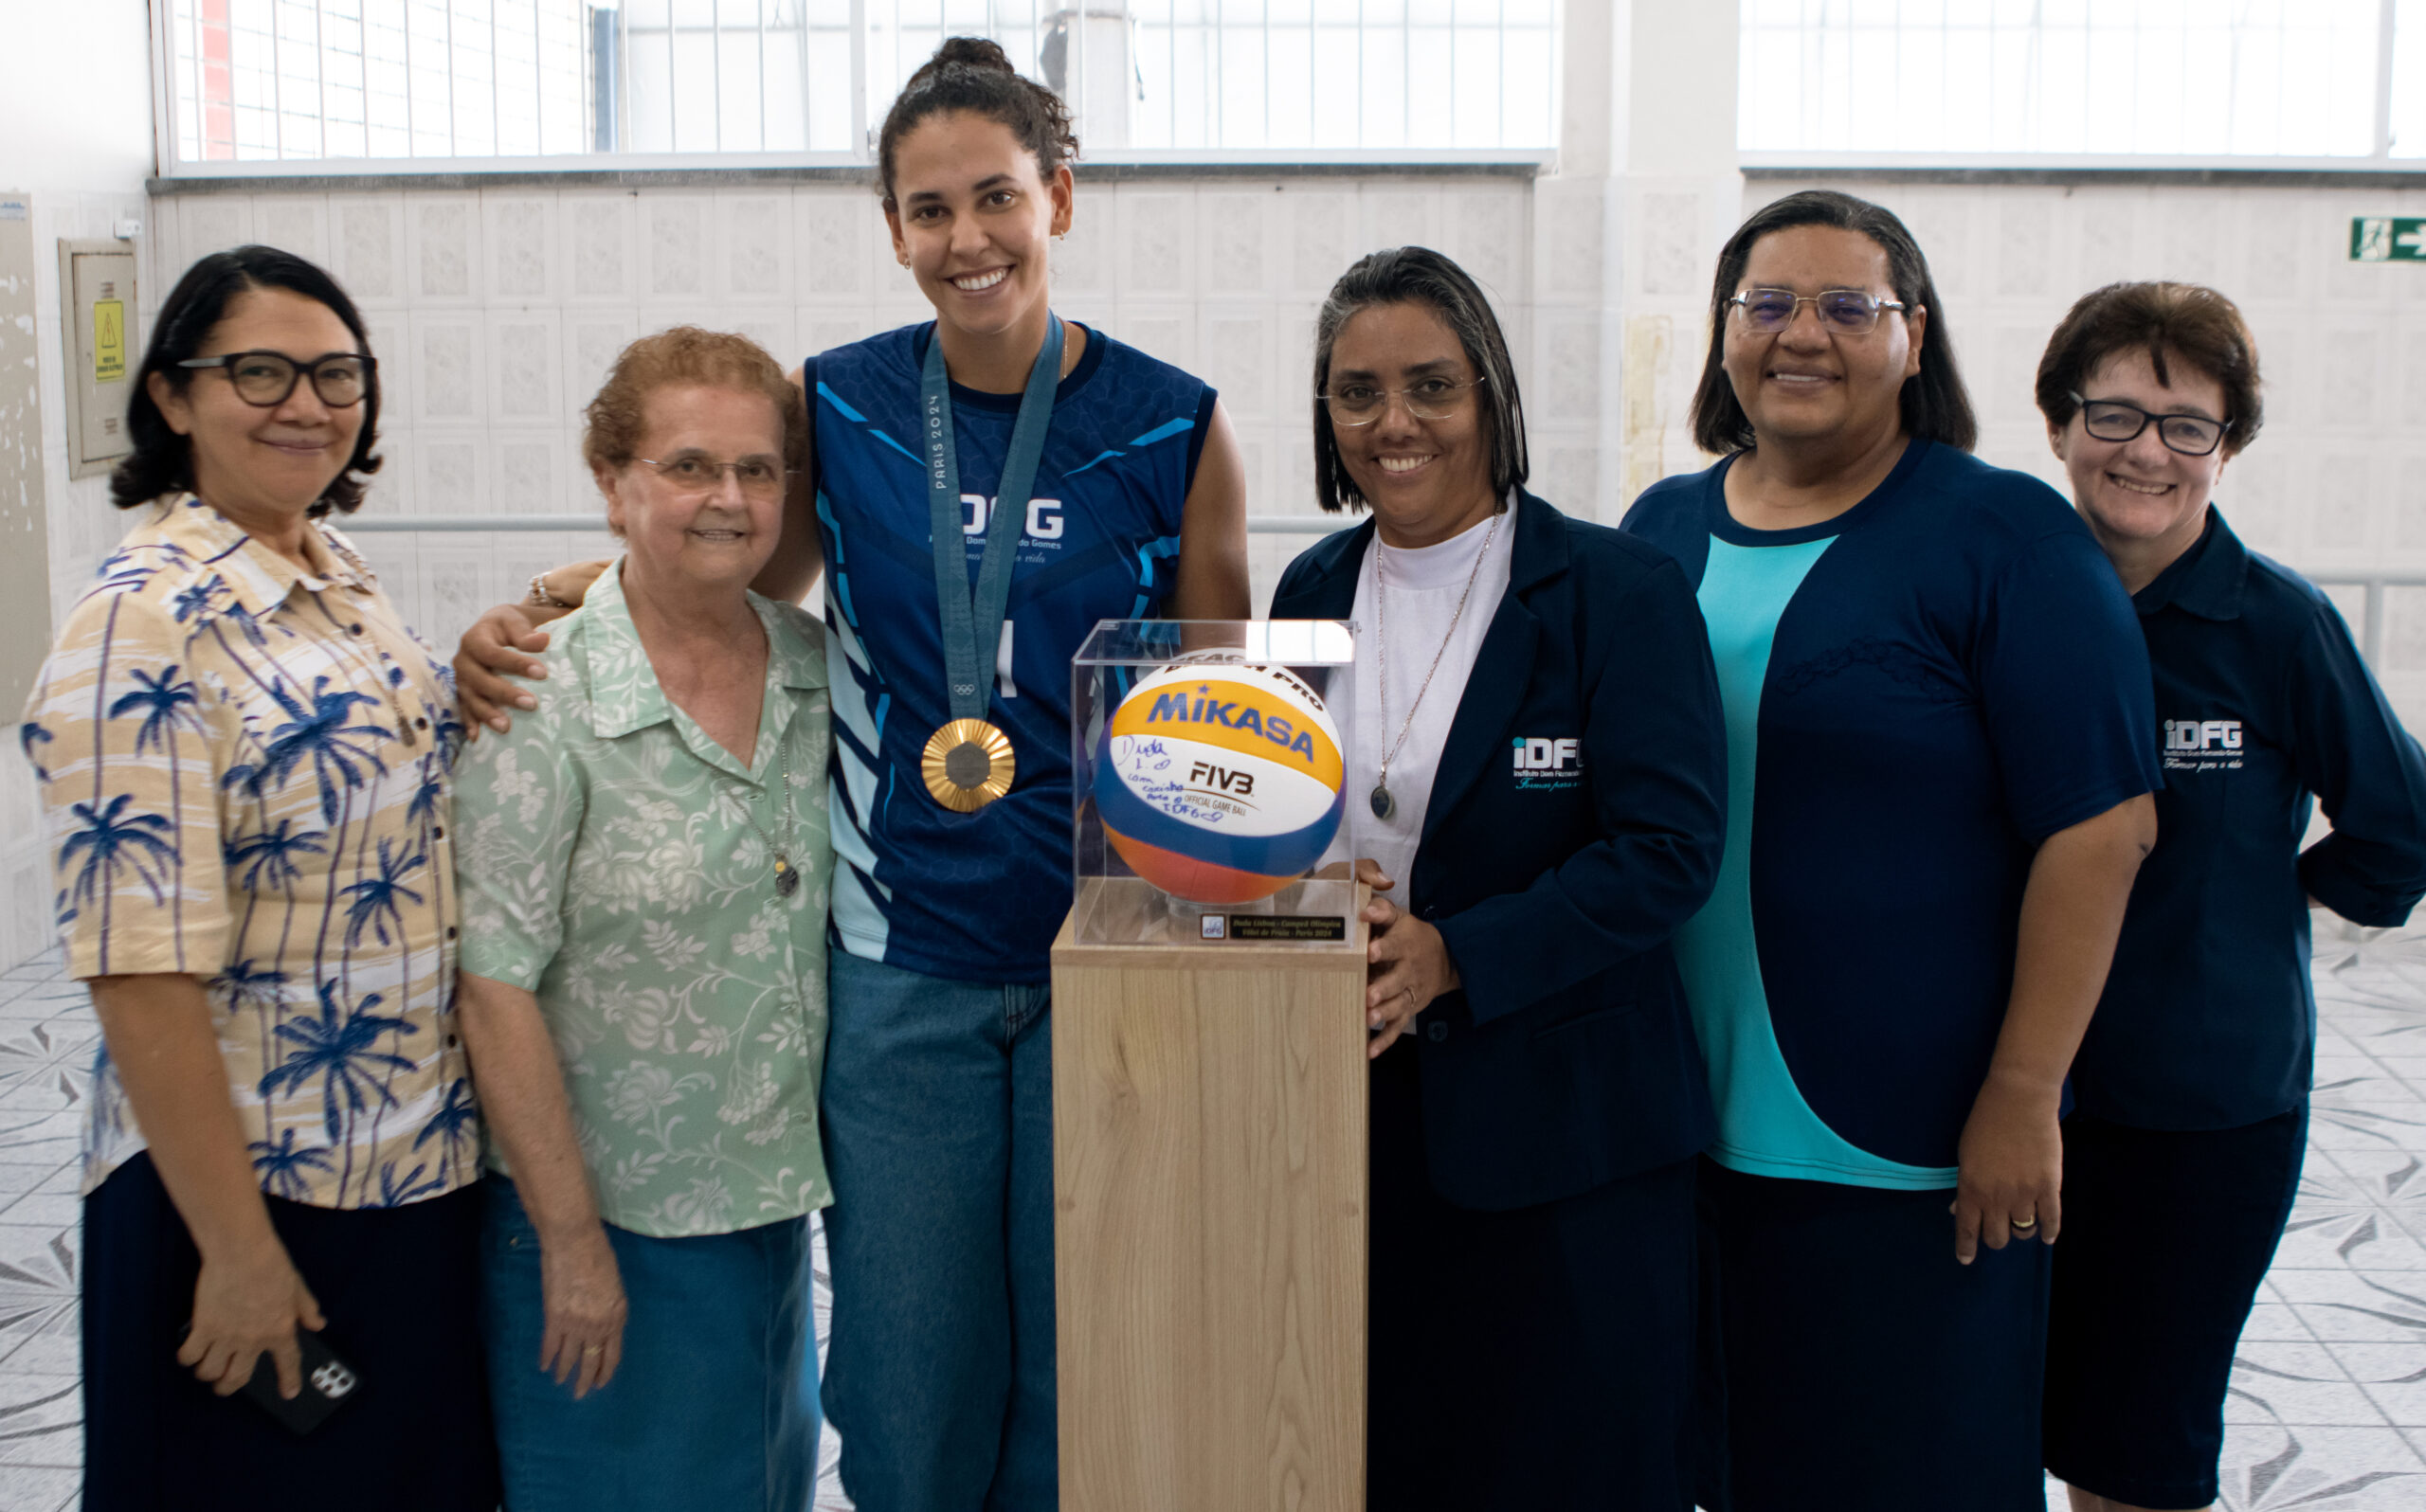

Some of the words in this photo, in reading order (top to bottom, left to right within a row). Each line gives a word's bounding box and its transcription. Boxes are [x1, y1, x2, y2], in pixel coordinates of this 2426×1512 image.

[929, 395, 942, 439] 2024
[932, 443, 947, 490] PARIS
[967, 536, 987, 546] Dom
[1031, 538, 1062, 550] Gomes
[1272, 672, 1324, 711] PRO
[1189, 761, 1254, 796] FIVB
[1185, 794, 1211, 809] OFFICIAL
[1212, 800, 1231, 813] GAME
[1232, 804, 1246, 817] BALL
